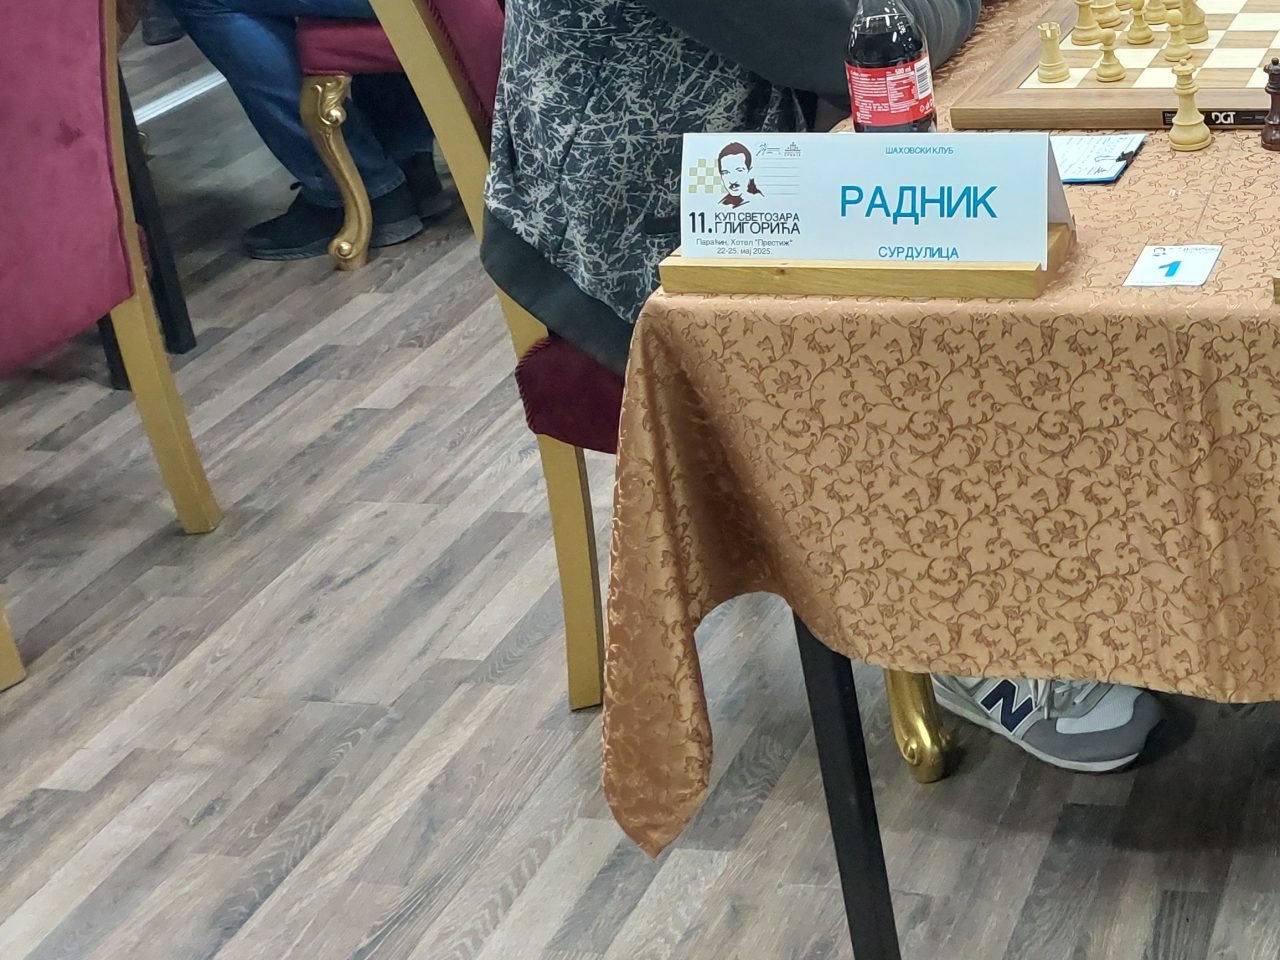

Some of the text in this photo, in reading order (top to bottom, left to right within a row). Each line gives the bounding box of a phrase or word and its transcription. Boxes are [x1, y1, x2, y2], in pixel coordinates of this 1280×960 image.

[1211, 112, 1236, 124] DGT
[841, 186, 998, 225] РАДНИК
[689, 212, 712, 233] 11.
[715, 212, 800, 222] КУП СВЕТОЗАРА
[715, 222, 800, 234] ГЛИГОРИЋА
[878, 246, 959, 260] СУРДУЛИЦА
[1158, 260, 1181, 277] 1
[980, 678, 1036, 735] N
